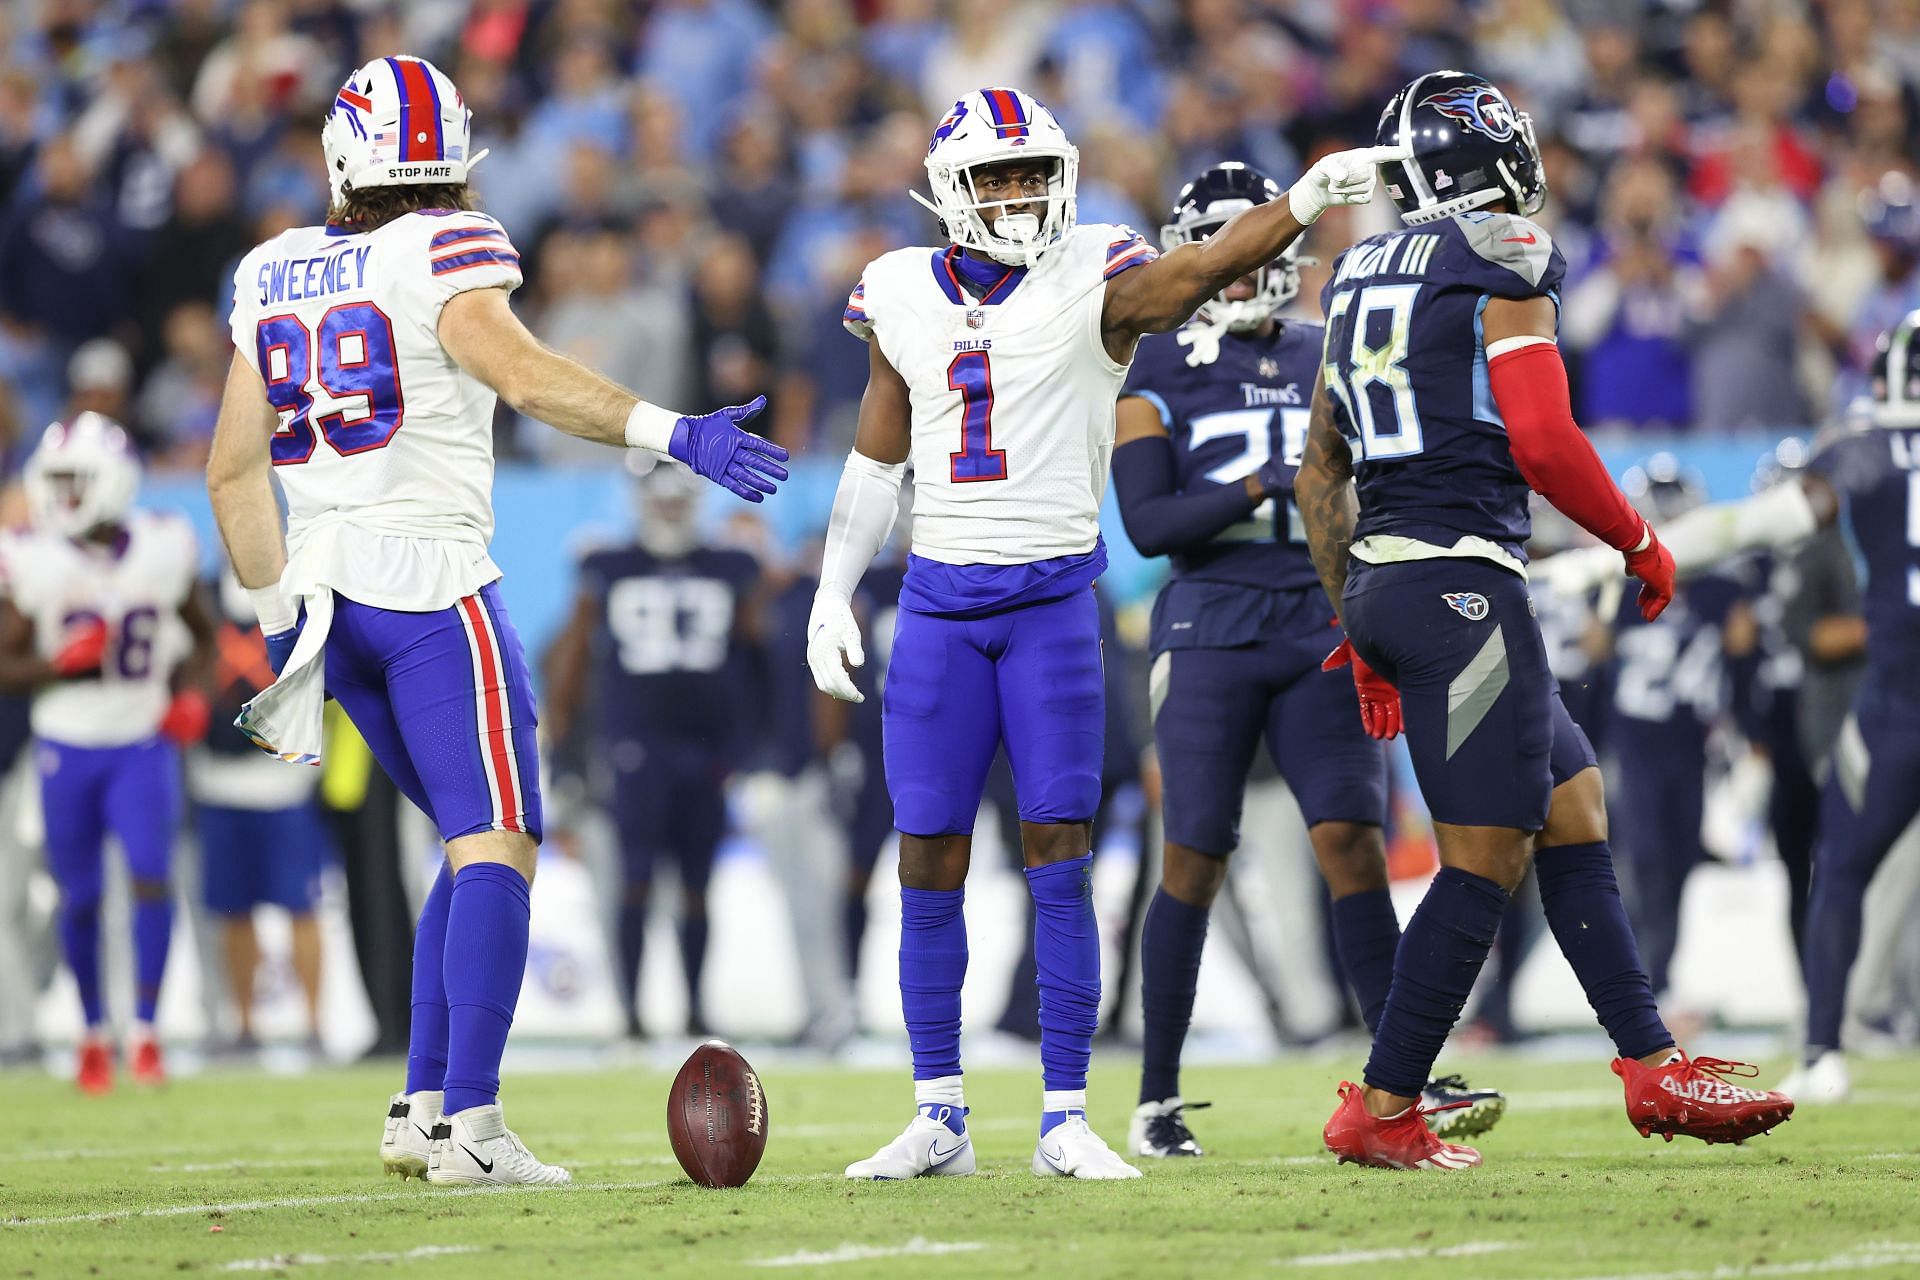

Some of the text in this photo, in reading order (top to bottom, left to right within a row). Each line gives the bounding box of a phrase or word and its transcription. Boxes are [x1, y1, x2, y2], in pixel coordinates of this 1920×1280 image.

[389, 167, 451, 178] STOP HATE
[257, 245, 372, 307] SWEENEY
[1397, 234, 1440, 276] III
[953, 339, 992, 351] BILLS
[256, 300, 404, 466] 89
[947, 350, 1008, 483] 1
